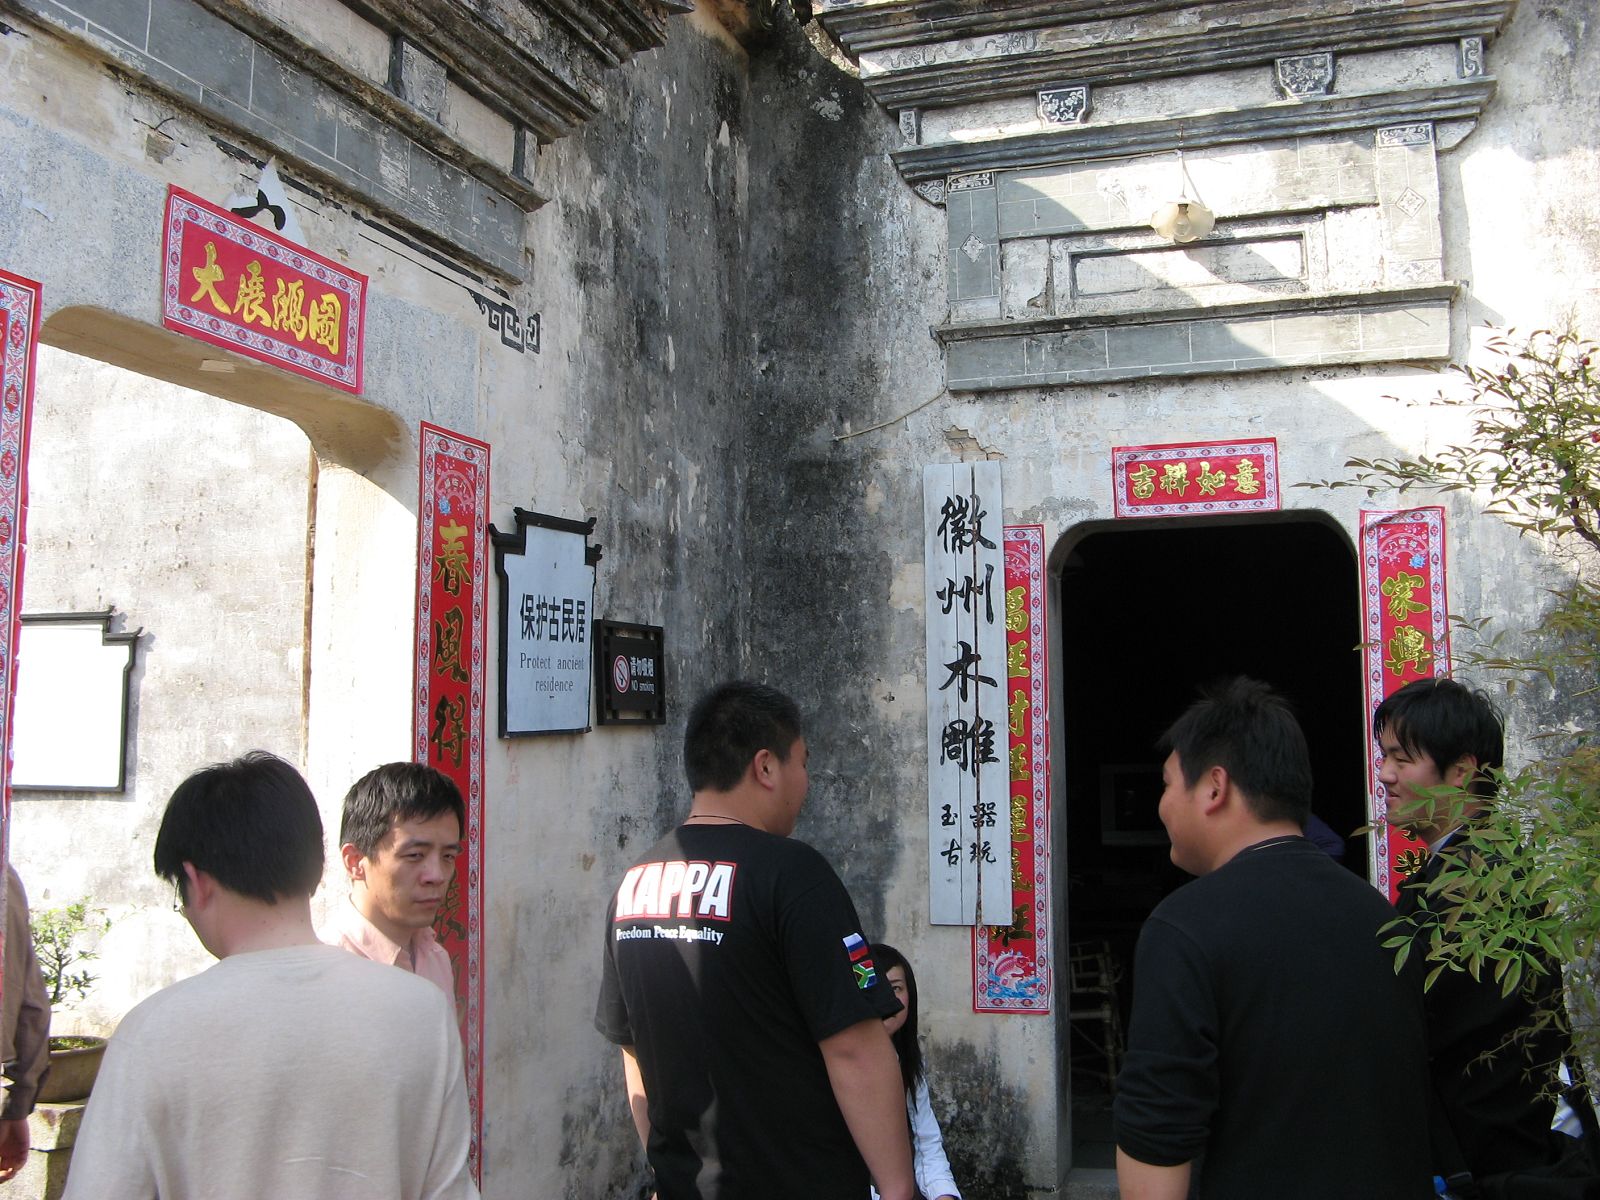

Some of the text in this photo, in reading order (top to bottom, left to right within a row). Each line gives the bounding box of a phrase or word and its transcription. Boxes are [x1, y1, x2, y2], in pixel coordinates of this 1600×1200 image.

[1129, 458, 1262, 499] 吉祥如意
[520, 592, 586, 644] 保护古民居
[936, 493, 1000, 778] 徽州木雕
[520, 652, 584, 670] Protect ancient
[535, 676, 574, 692] residence
[940, 801, 998, 829] 玉器
[940, 838, 998, 866] 古玩
[615, 860, 737, 921] KAPPA
[616, 925, 724, 945] Freedom Peace Equality
